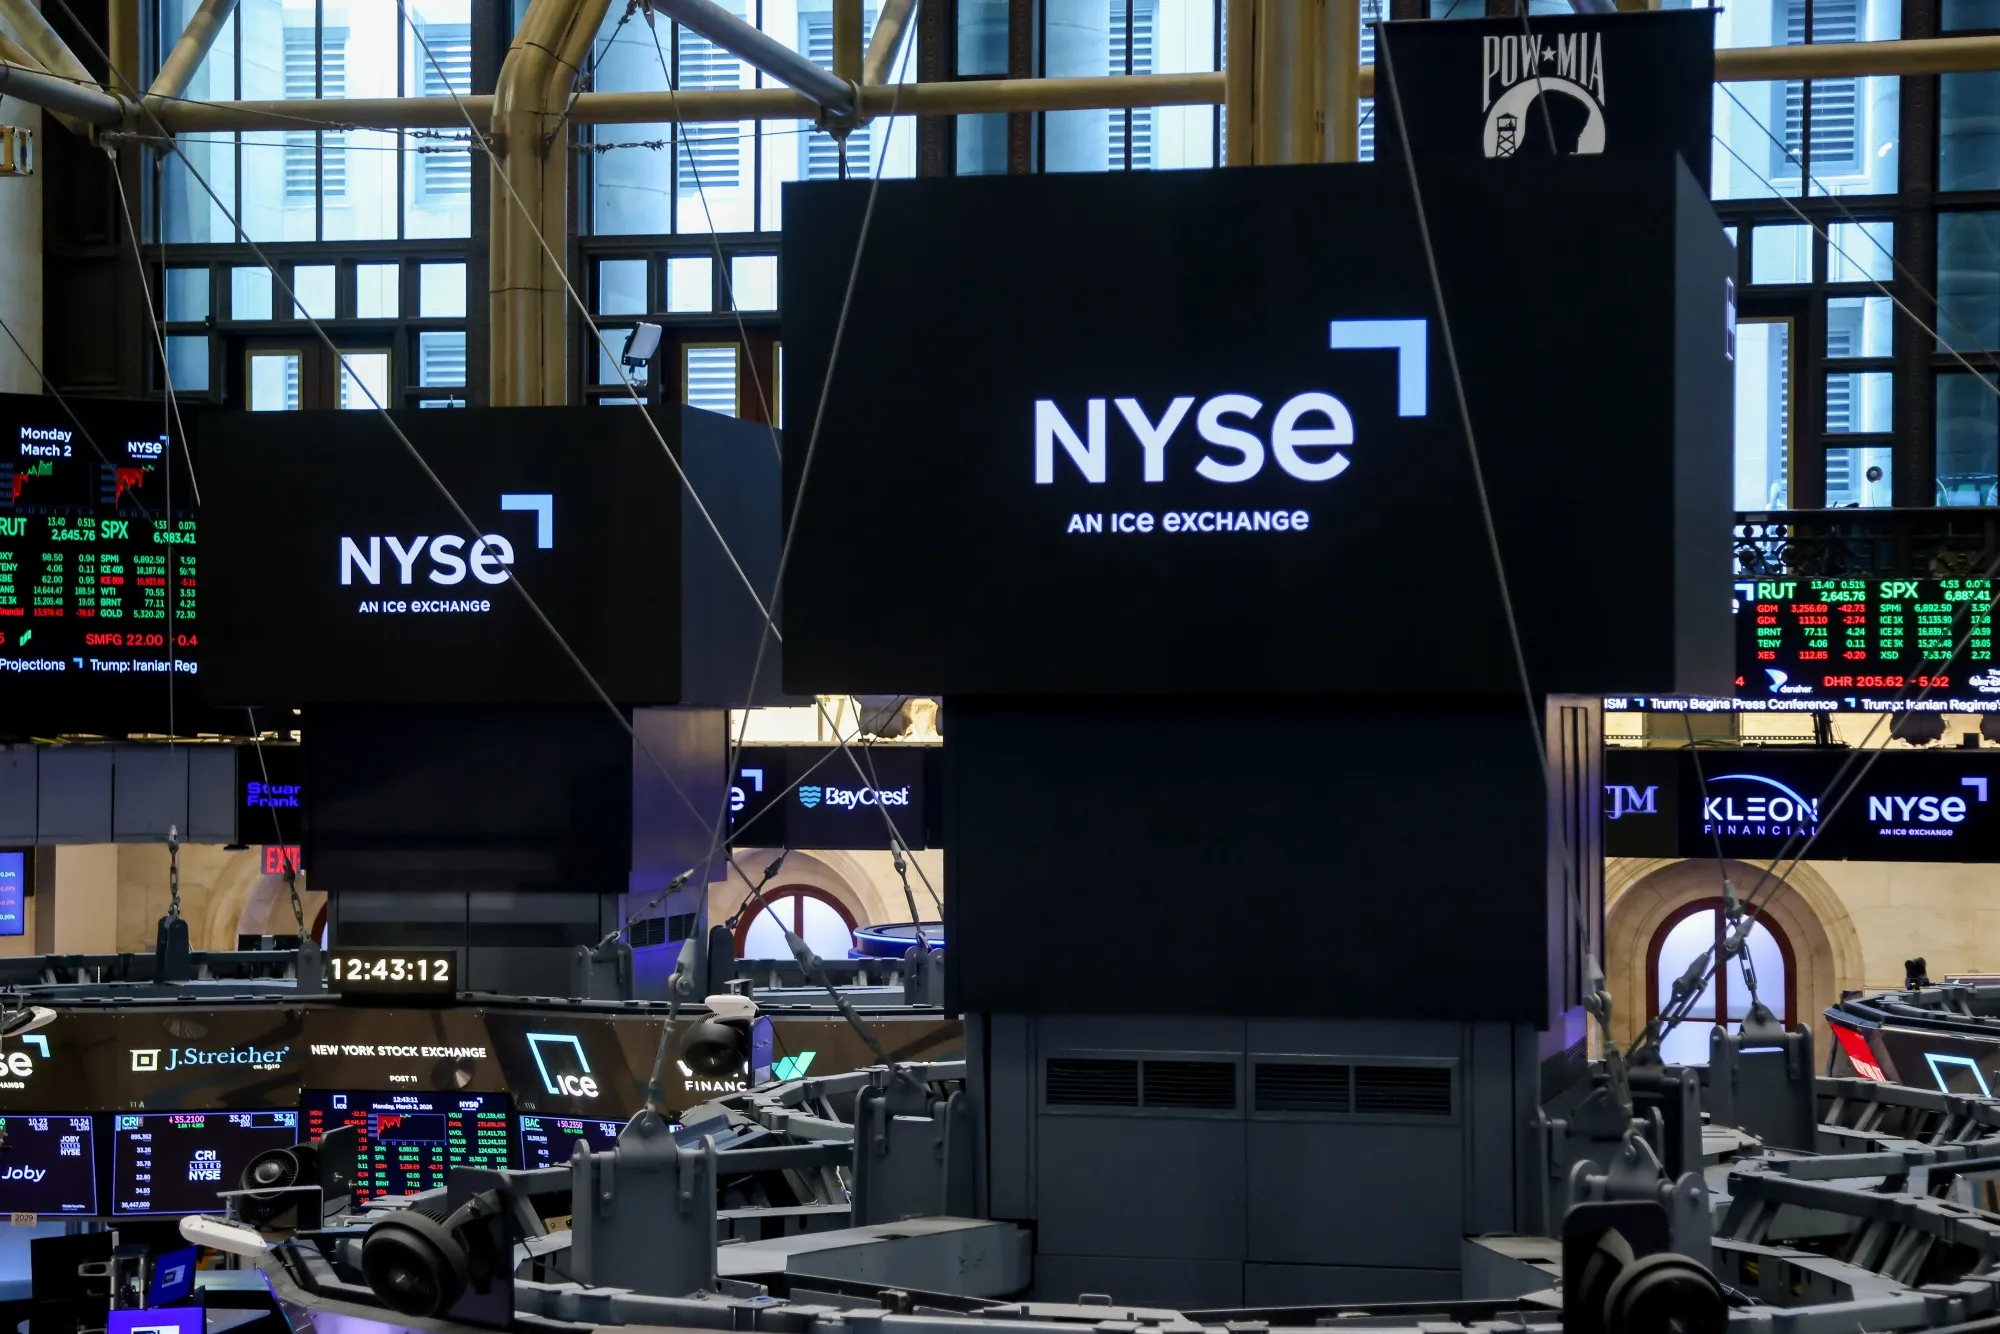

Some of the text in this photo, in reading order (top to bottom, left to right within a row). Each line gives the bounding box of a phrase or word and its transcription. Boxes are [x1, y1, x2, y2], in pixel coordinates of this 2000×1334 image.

[1483, 32, 1605, 113] POW MIA
[21, 427, 72, 443] Monday
[21, 443, 71, 457] March 2
[0, 517, 95, 536] RUT 13.40 0.51%
[1067, 513, 1102, 533] AN
[52, 529, 95, 541] 2,645.76
[101, 520, 196, 539] SPX 0.07%
[42, 553, 94, 562] 98.50 0.94
[134, 556, 165, 564] 6,892.50
[47, 564, 63, 572] 4.06
[79, 565, 94, 573] 0.11
[101, 565, 111, 573] ICE
[112, 566, 123, 574] 400
[42, 575, 95, 584] 62.00 0.95
[101, 587, 195, 597] WTI 70.55 3.53
[1758, 581, 1865, 599] RUT 13.40 0.51%
[1880, 582, 1918, 598] SPX
[1940, 580, 1959, 588] 4.53
[79, 598, 95, 606] 19.05
[1820, 591, 1865, 602] 2,645.76
[101, 598, 195, 608] BRNT 77.11 4.24
[359, 601, 378, 612] AN
[1756, 604, 1865, 613] GDM 3,256.69 -42.73
[1914, 604, 1992, 613] 6,892.50 3.50
[100, 609, 195, 619] GOLD 5,320.20 72.30
[1757, 616, 1865, 624] GDX 113.10 -2.74
[1880, 616, 1952, 624] ICE 1K 15,135.90
[1757, 628, 1865, 636] BRNT 77.11 4.24
[1880, 628, 1903, 636] ICE 2K
[86, 633, 122, 645] SMFG
[127, 634, 163, 646] 22.00
[1758, 639, 1865, 648] TENY 4.06 0.11
[1880, 639, 1991, 647] ICE 3K 19.05
[1758, 651, 1866, 660] XES 112.85 -0.20
[1880, 651, 1991, 659] XSD 2.72
[0, 658, 197, 674] Projections Trump: Iranian Reg
[1824, 676, 1853, 686] DHR
[1856, 676, 1903, 687] 205.62
[1604, 698, 1627, 709] ISM
[1650, 698, 1688, 711] Trump
[1689, 697, 1731, 711] Begins
[1731, 698, 1766, 710] Press
[1767, 699, 1838, 710] Conference
[1861, 699, 1904, 712] Trump:
[1906, 699, 1947, 710] Iranian
[247, 782, 301, 794] Stuar
[247, 795, 300, 807] Frank
[826, 786, 909, 809] BayCrest
[1704, 795, 1818, 822] KLEON
[332, 958, 448, 981] 12:43:12
[311, 1045, 487, 1059] NEW YORK STOCK EXCHANGE
[165, 1046, 286, 1071] J.Streicher
[685, 1081, 747, 1092] FINANC
[373, 1102, 396, 1110] Monday,
[28, 1118, 90, 1126] 10.23 10.24
[122, 1113, 294, 1126] CRI 35.2100 35.20 35.21
[525, 1118, 616, 1131] BAC 50.2350 50.23
[60, 1136, 80, 1144] JOBY
[195, 1150, 216, 1160] CRI
[1, 1165, 46, 1182] Joby
[189, 1170, 221, 1180] NYSE
[15, 1214, 34, 1222] 2029
